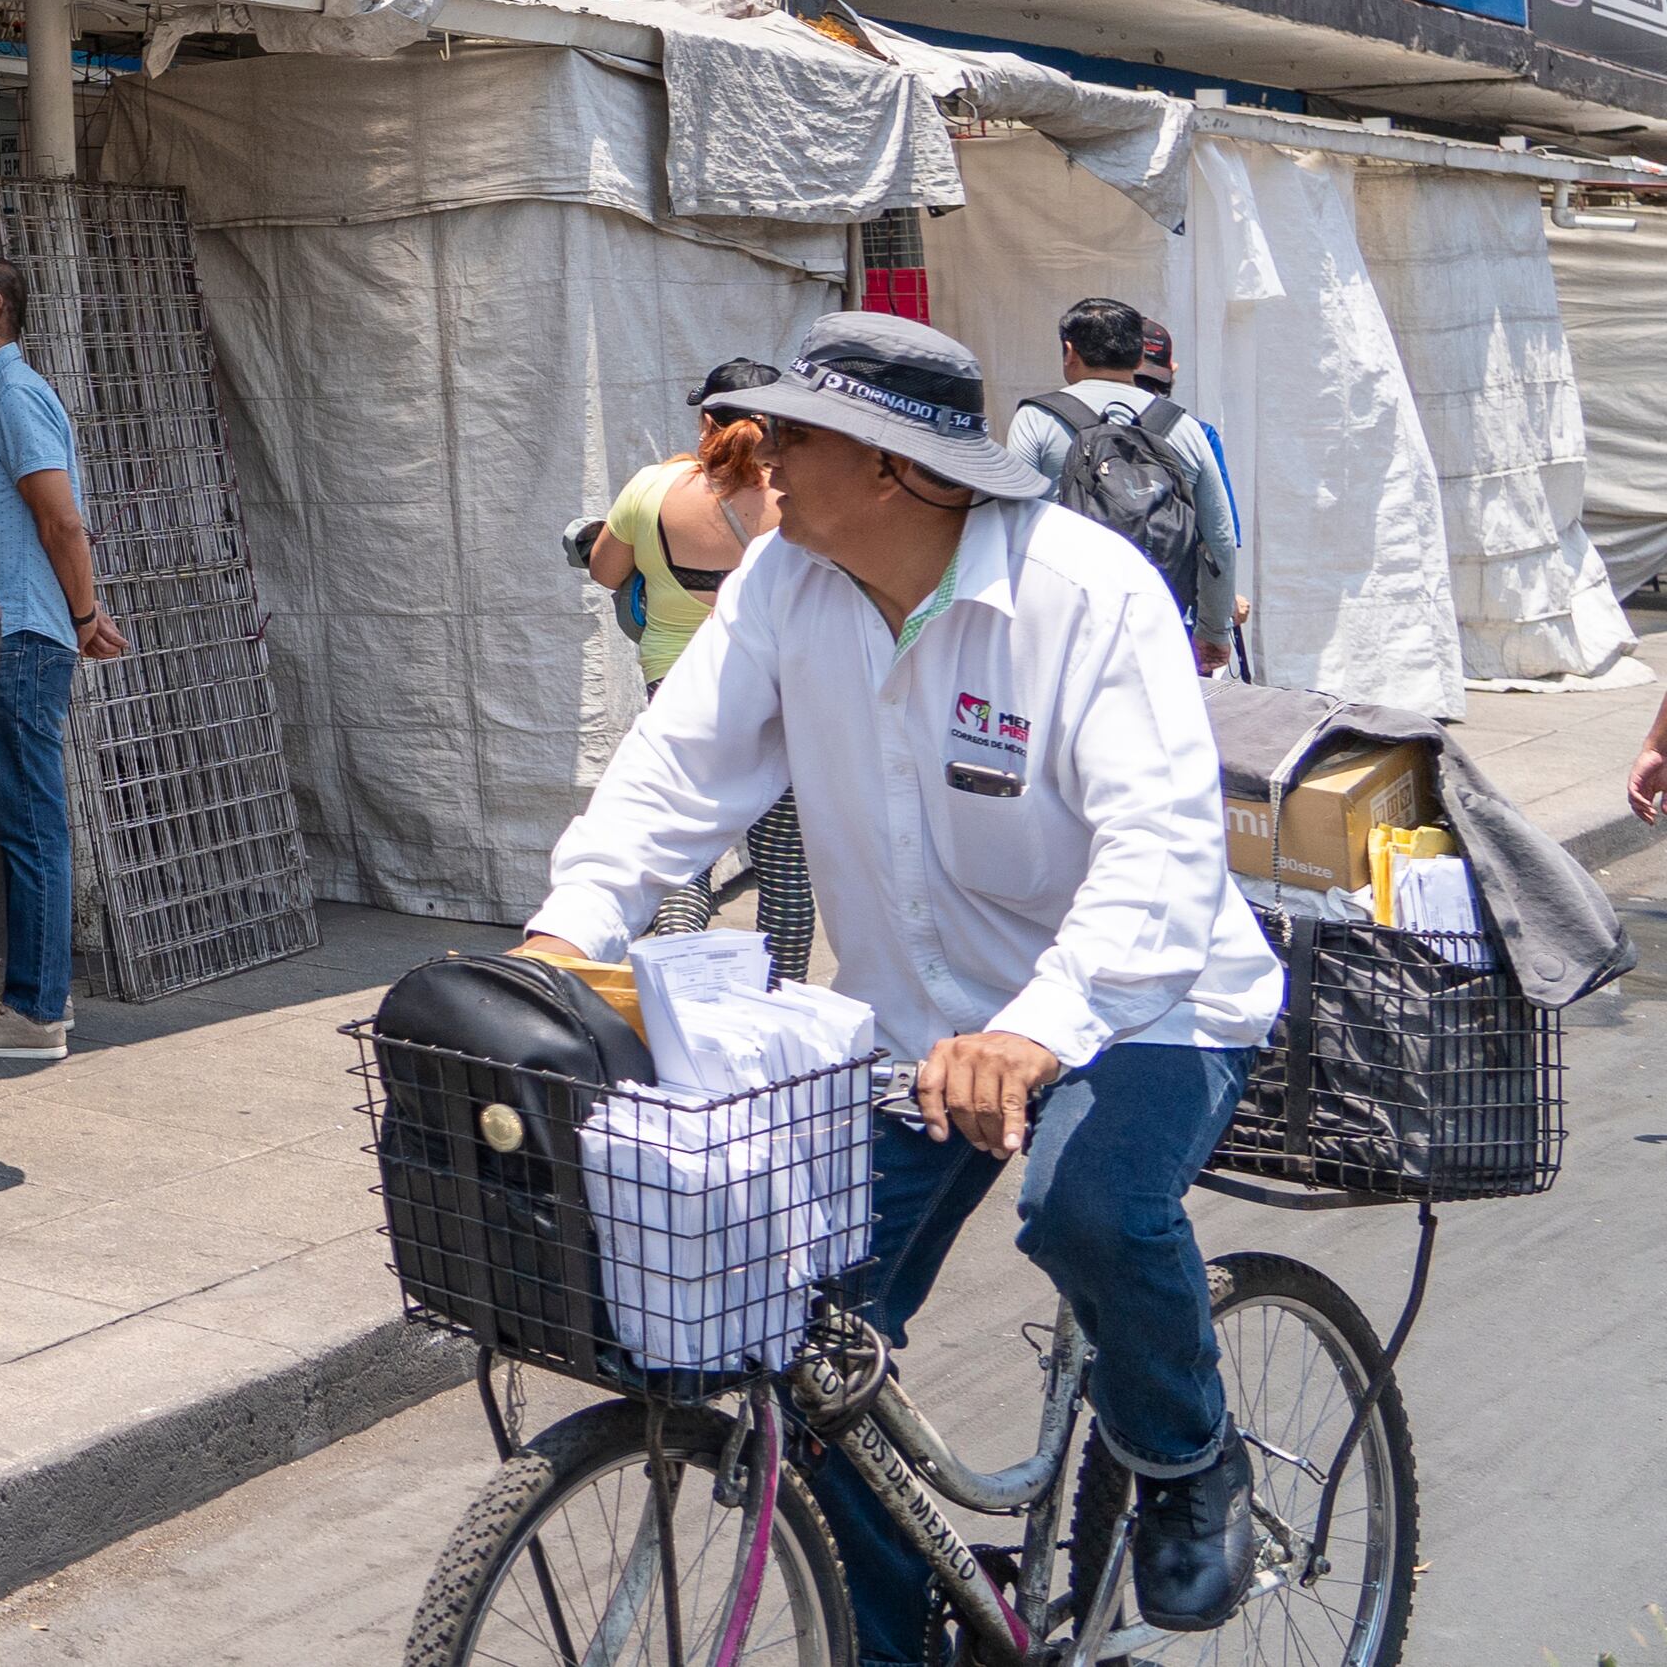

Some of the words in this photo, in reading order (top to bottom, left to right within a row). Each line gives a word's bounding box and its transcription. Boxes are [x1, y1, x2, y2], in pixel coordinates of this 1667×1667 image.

[846, 380, 933, 420] TORNADO
[950, 728, 990, 747] CORREOS
[990, 740, 1003, 750] DE
[884, 1461, 913, 1498] DE
[908, 1491, 977, 1581] MEXICO
